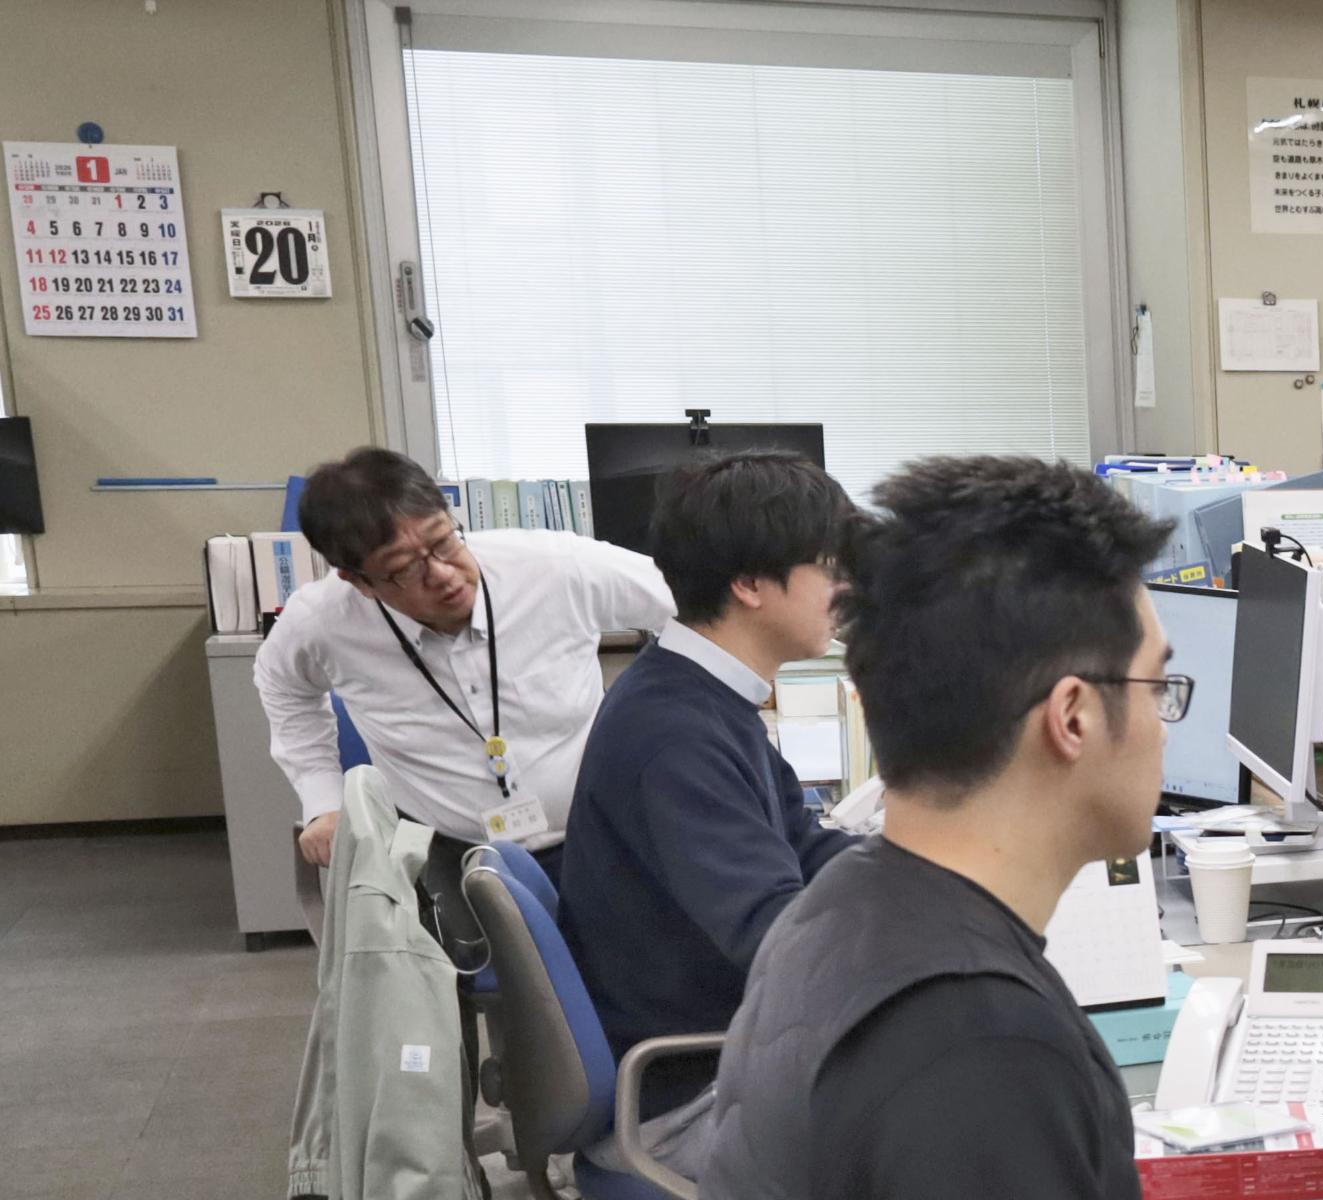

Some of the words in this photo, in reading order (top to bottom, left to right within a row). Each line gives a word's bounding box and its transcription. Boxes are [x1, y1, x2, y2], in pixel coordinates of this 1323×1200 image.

[86, 160, 98, 180] 1
[115, 195, 122, 208] 1
[137, 195, 146, 209] 2
[160, 196, 168, 210] 3
[27, 220, 36, 235] 4
[50, 221, 58, 235] 5
[73, 221, 82, 236] 6
[95, 222, 103, 236] 7
[118, 223, 126, 237] 8
[140, 223, 149, 237] 9
[158, 224, 176, 238] 10
[26, 249, 42, 263] 11
[49, 249, 66, 263] 12
[72, 250, 90, 264] 13
[95, 250, 112, 265] 14
[117, 251, 134, 265] 15
[139, 251, 157, 265] 16
[162, 252, 178, 265] 17
[245, 227, 309, 285] 20
[30, 278, 47, 291] 18
[52, 278, 70, 292] 19
[75, 278, 92, 292] 20
[98, 279, 114, 292] 21
[120, 279, 138, 293] 22
[142, 279, 160, 293] 23
[165, 280, 182, 293] 24
[33, 306, 50, 320] 25
[56, 306, 73, 320] 26
[78, 307, 95, 320] 27
[101, 307, 118, 320] 28
[123, 307, 140, 321] 29
[146, 308, 163, 321] 30
[168, 308, 184, 321] 31
